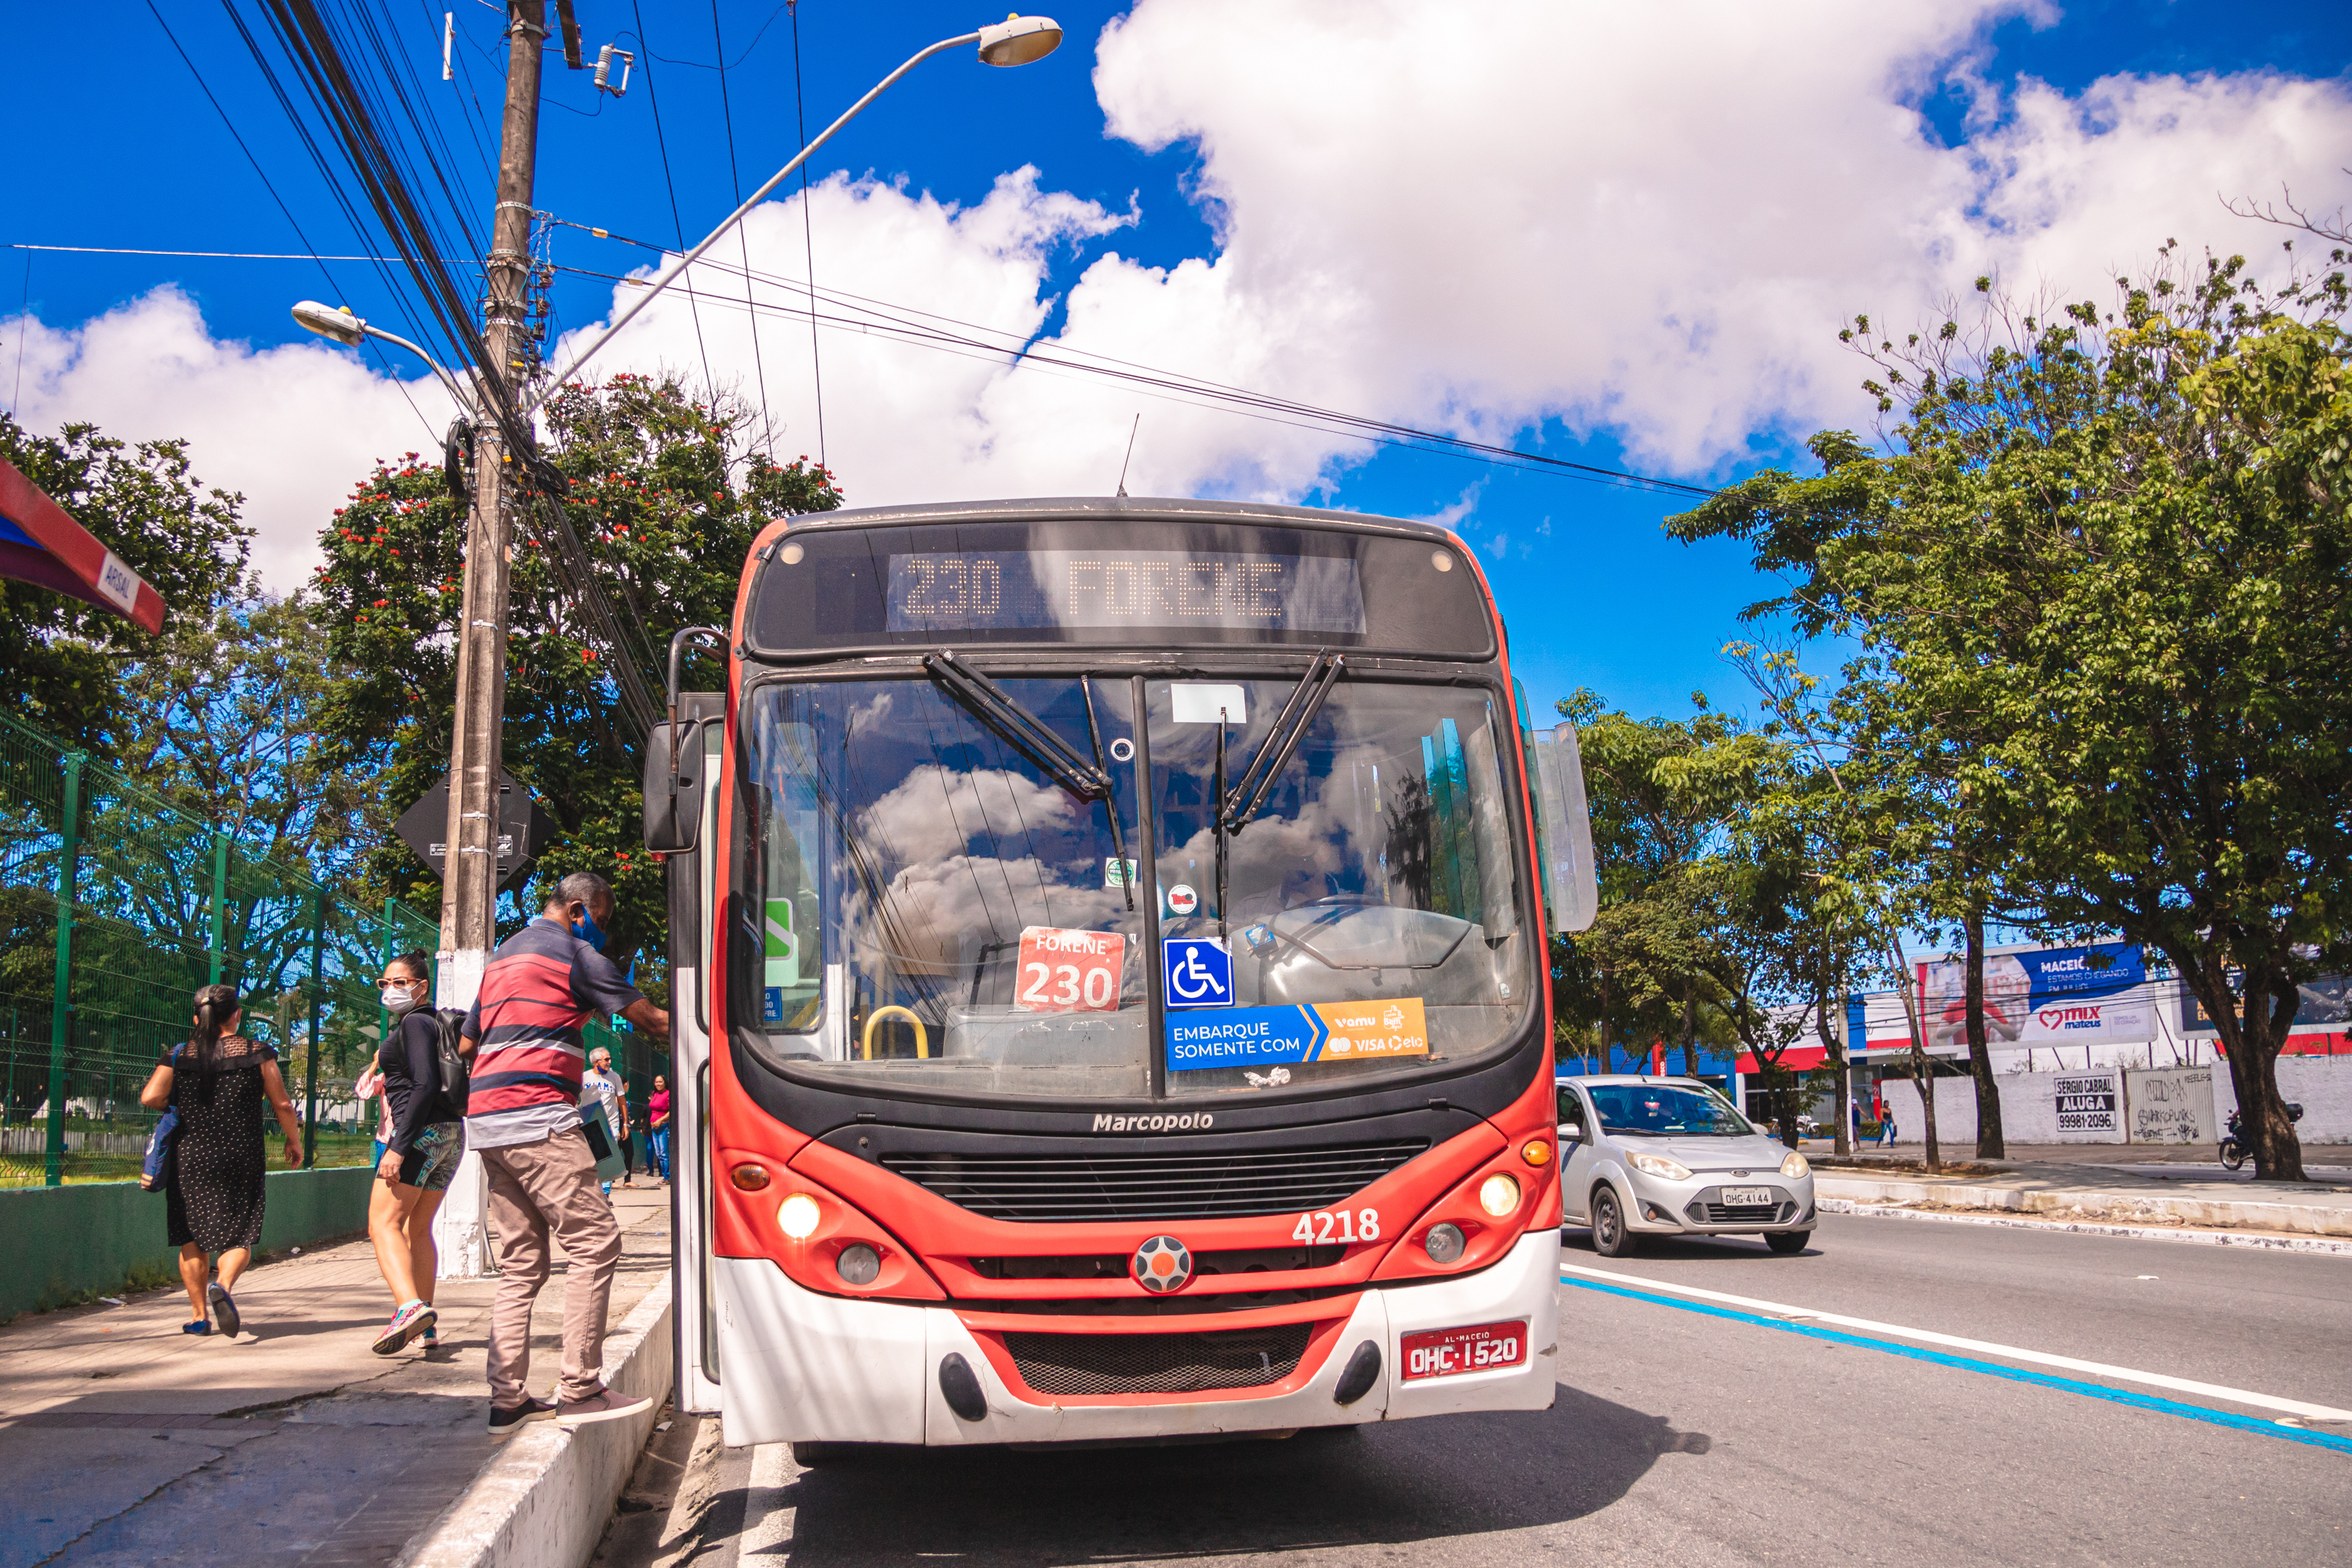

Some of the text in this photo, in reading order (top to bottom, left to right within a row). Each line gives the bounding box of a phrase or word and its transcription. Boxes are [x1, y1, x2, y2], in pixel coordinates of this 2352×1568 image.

[105, 564, 131, 599] ARSAL
[905, 559, 1282, 617] 230 FORENE
[1036, 935, 1107, 955] FORENE
[1022, 961, 1113, 1008] 230
[1383, 1018, 1401, 1026] Bem
[2064, 1006, 2102, 1022] mix
[1173, 1022, 1270, 1041] EMBARQUE
[2064, 1020, 2102, 1029] mateus
[1174, 1037, 1300, 1059] SOMENTE COM
[1352, 1038, 1386, 1052] VISA
[2085, 1078, 2113, 1094] CABRAL
[2061, 1096, 2107, 1112] ALUGA
[1092, 1112, 1214, 1133] Marcopolo
[1291, 1207, 1381, 1246] 4218
